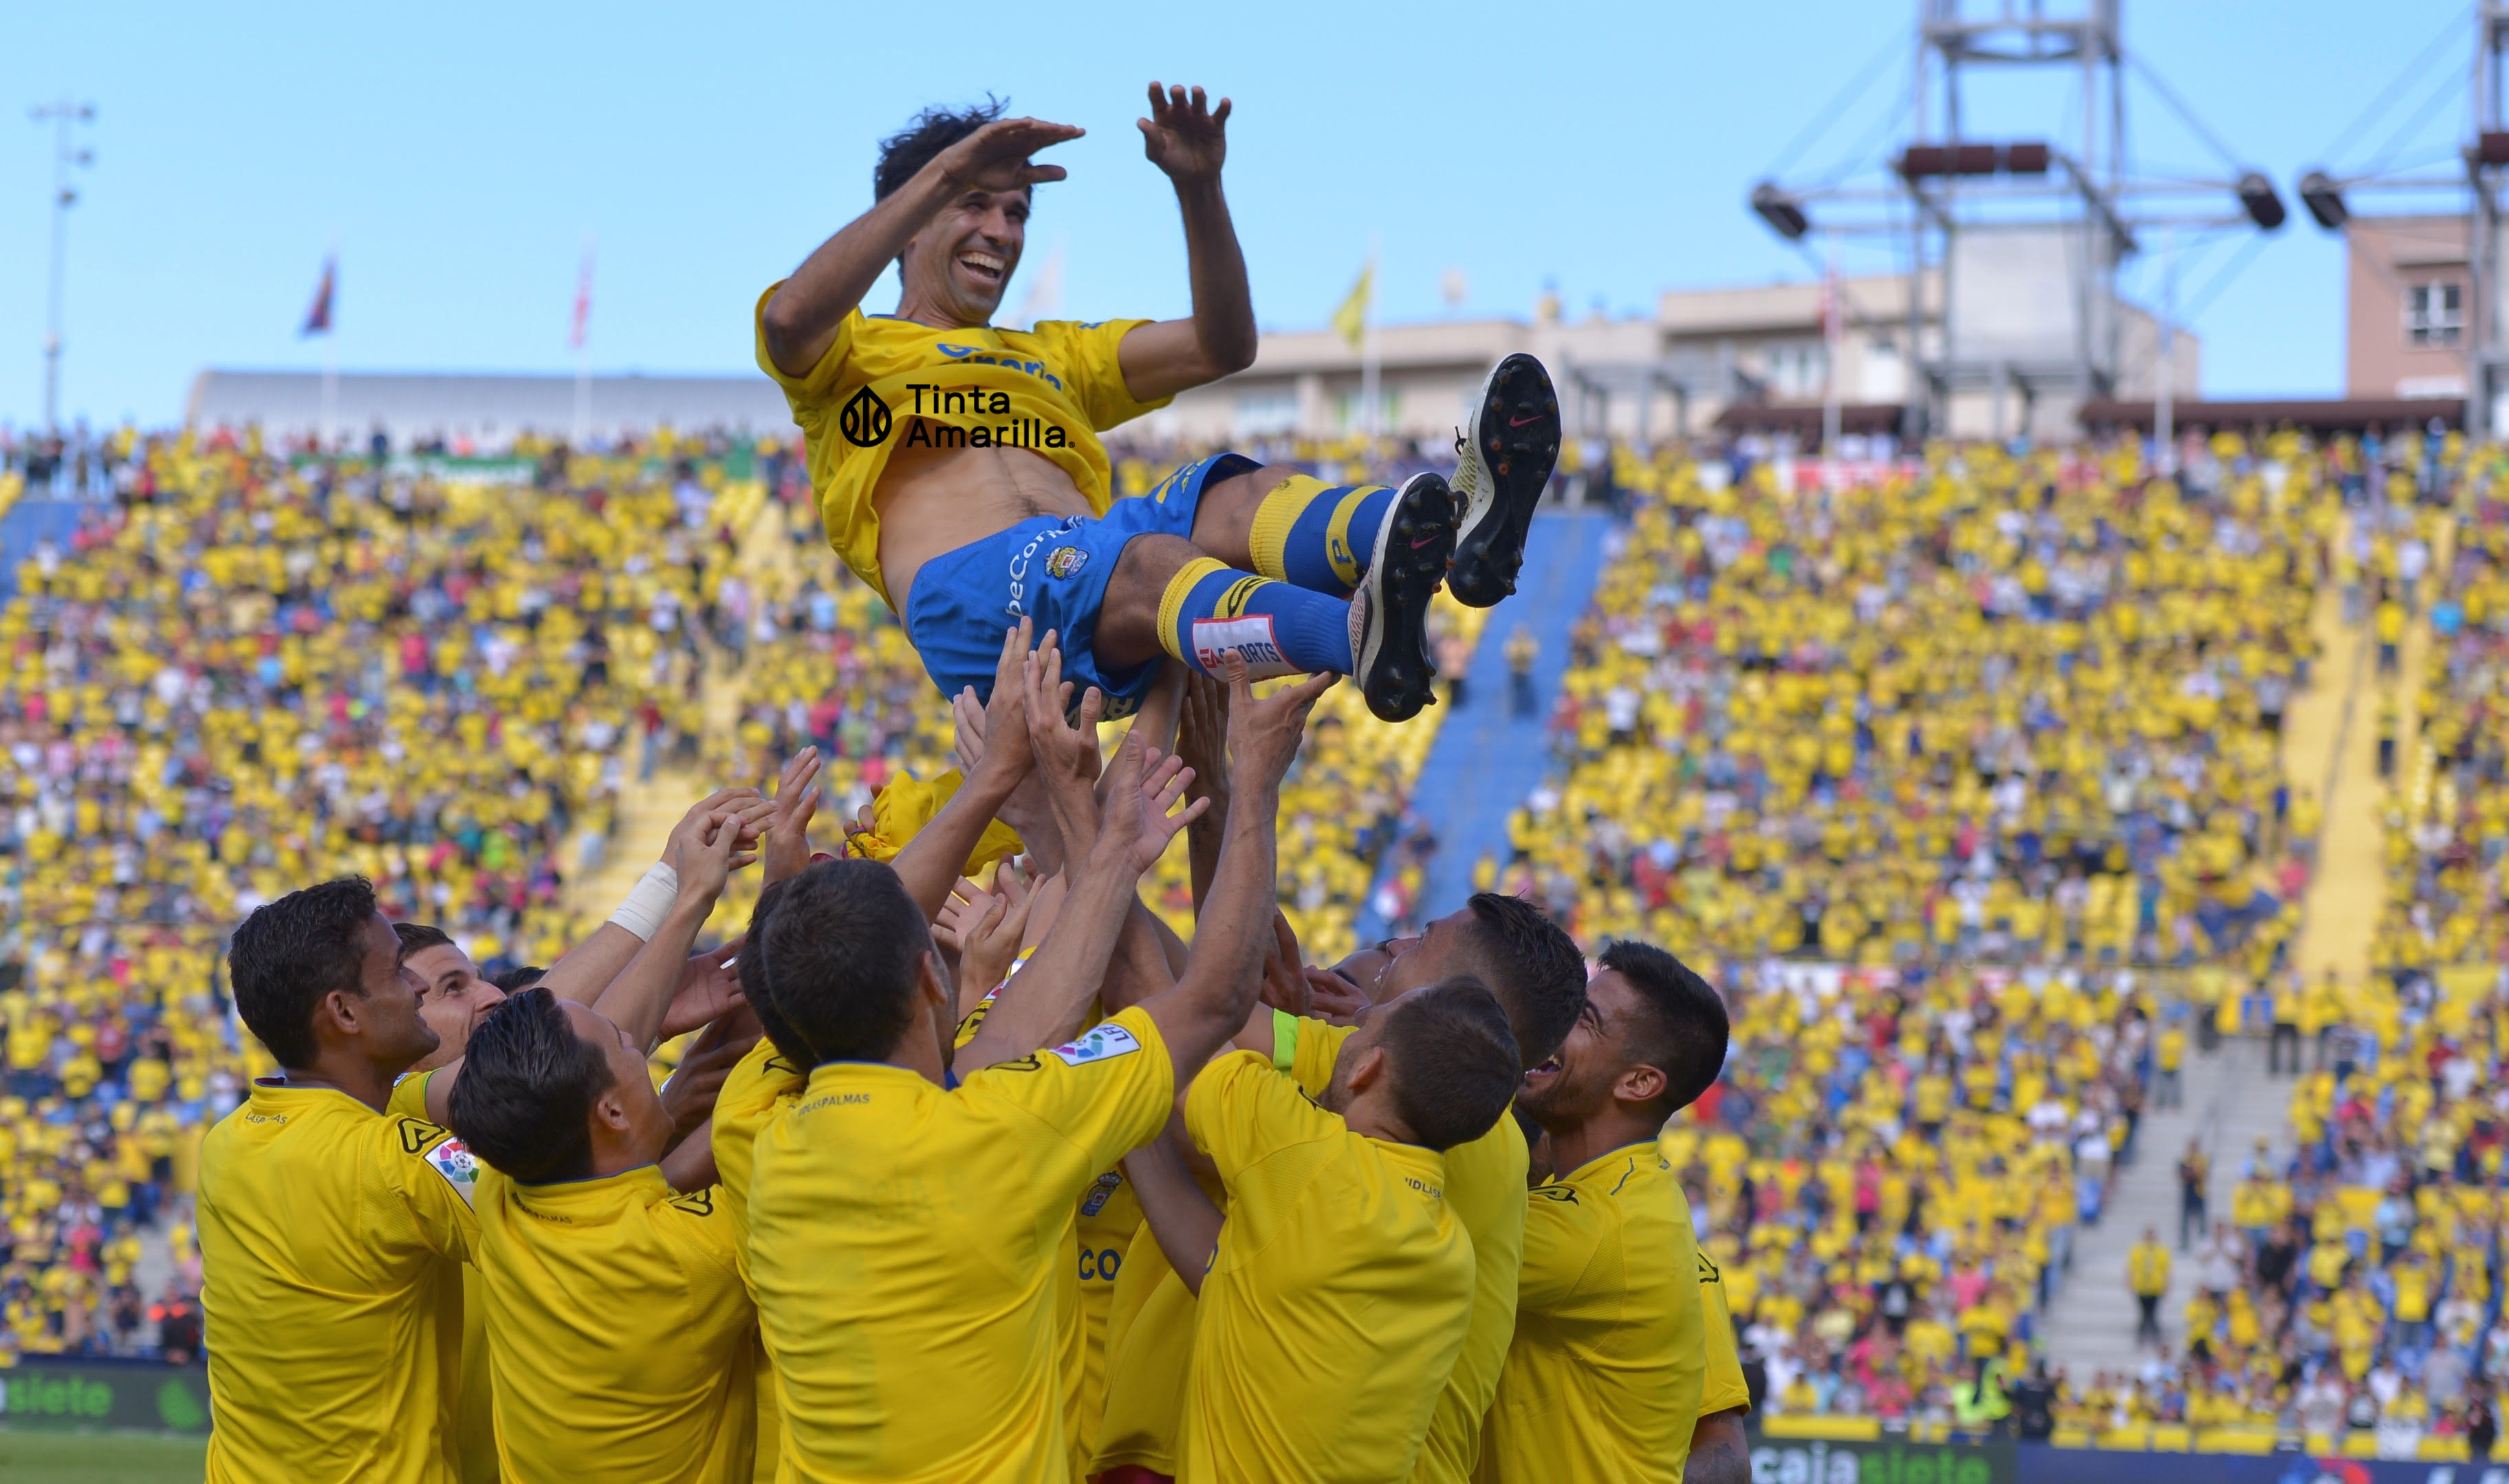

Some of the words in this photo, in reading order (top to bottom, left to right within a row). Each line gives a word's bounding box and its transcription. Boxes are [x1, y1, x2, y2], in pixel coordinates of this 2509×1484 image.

[1218, 642, 1282, 664] ORTS
[1078, 1248, 1122, 1281] CO
[0, 1371, 114, 1417] siete
